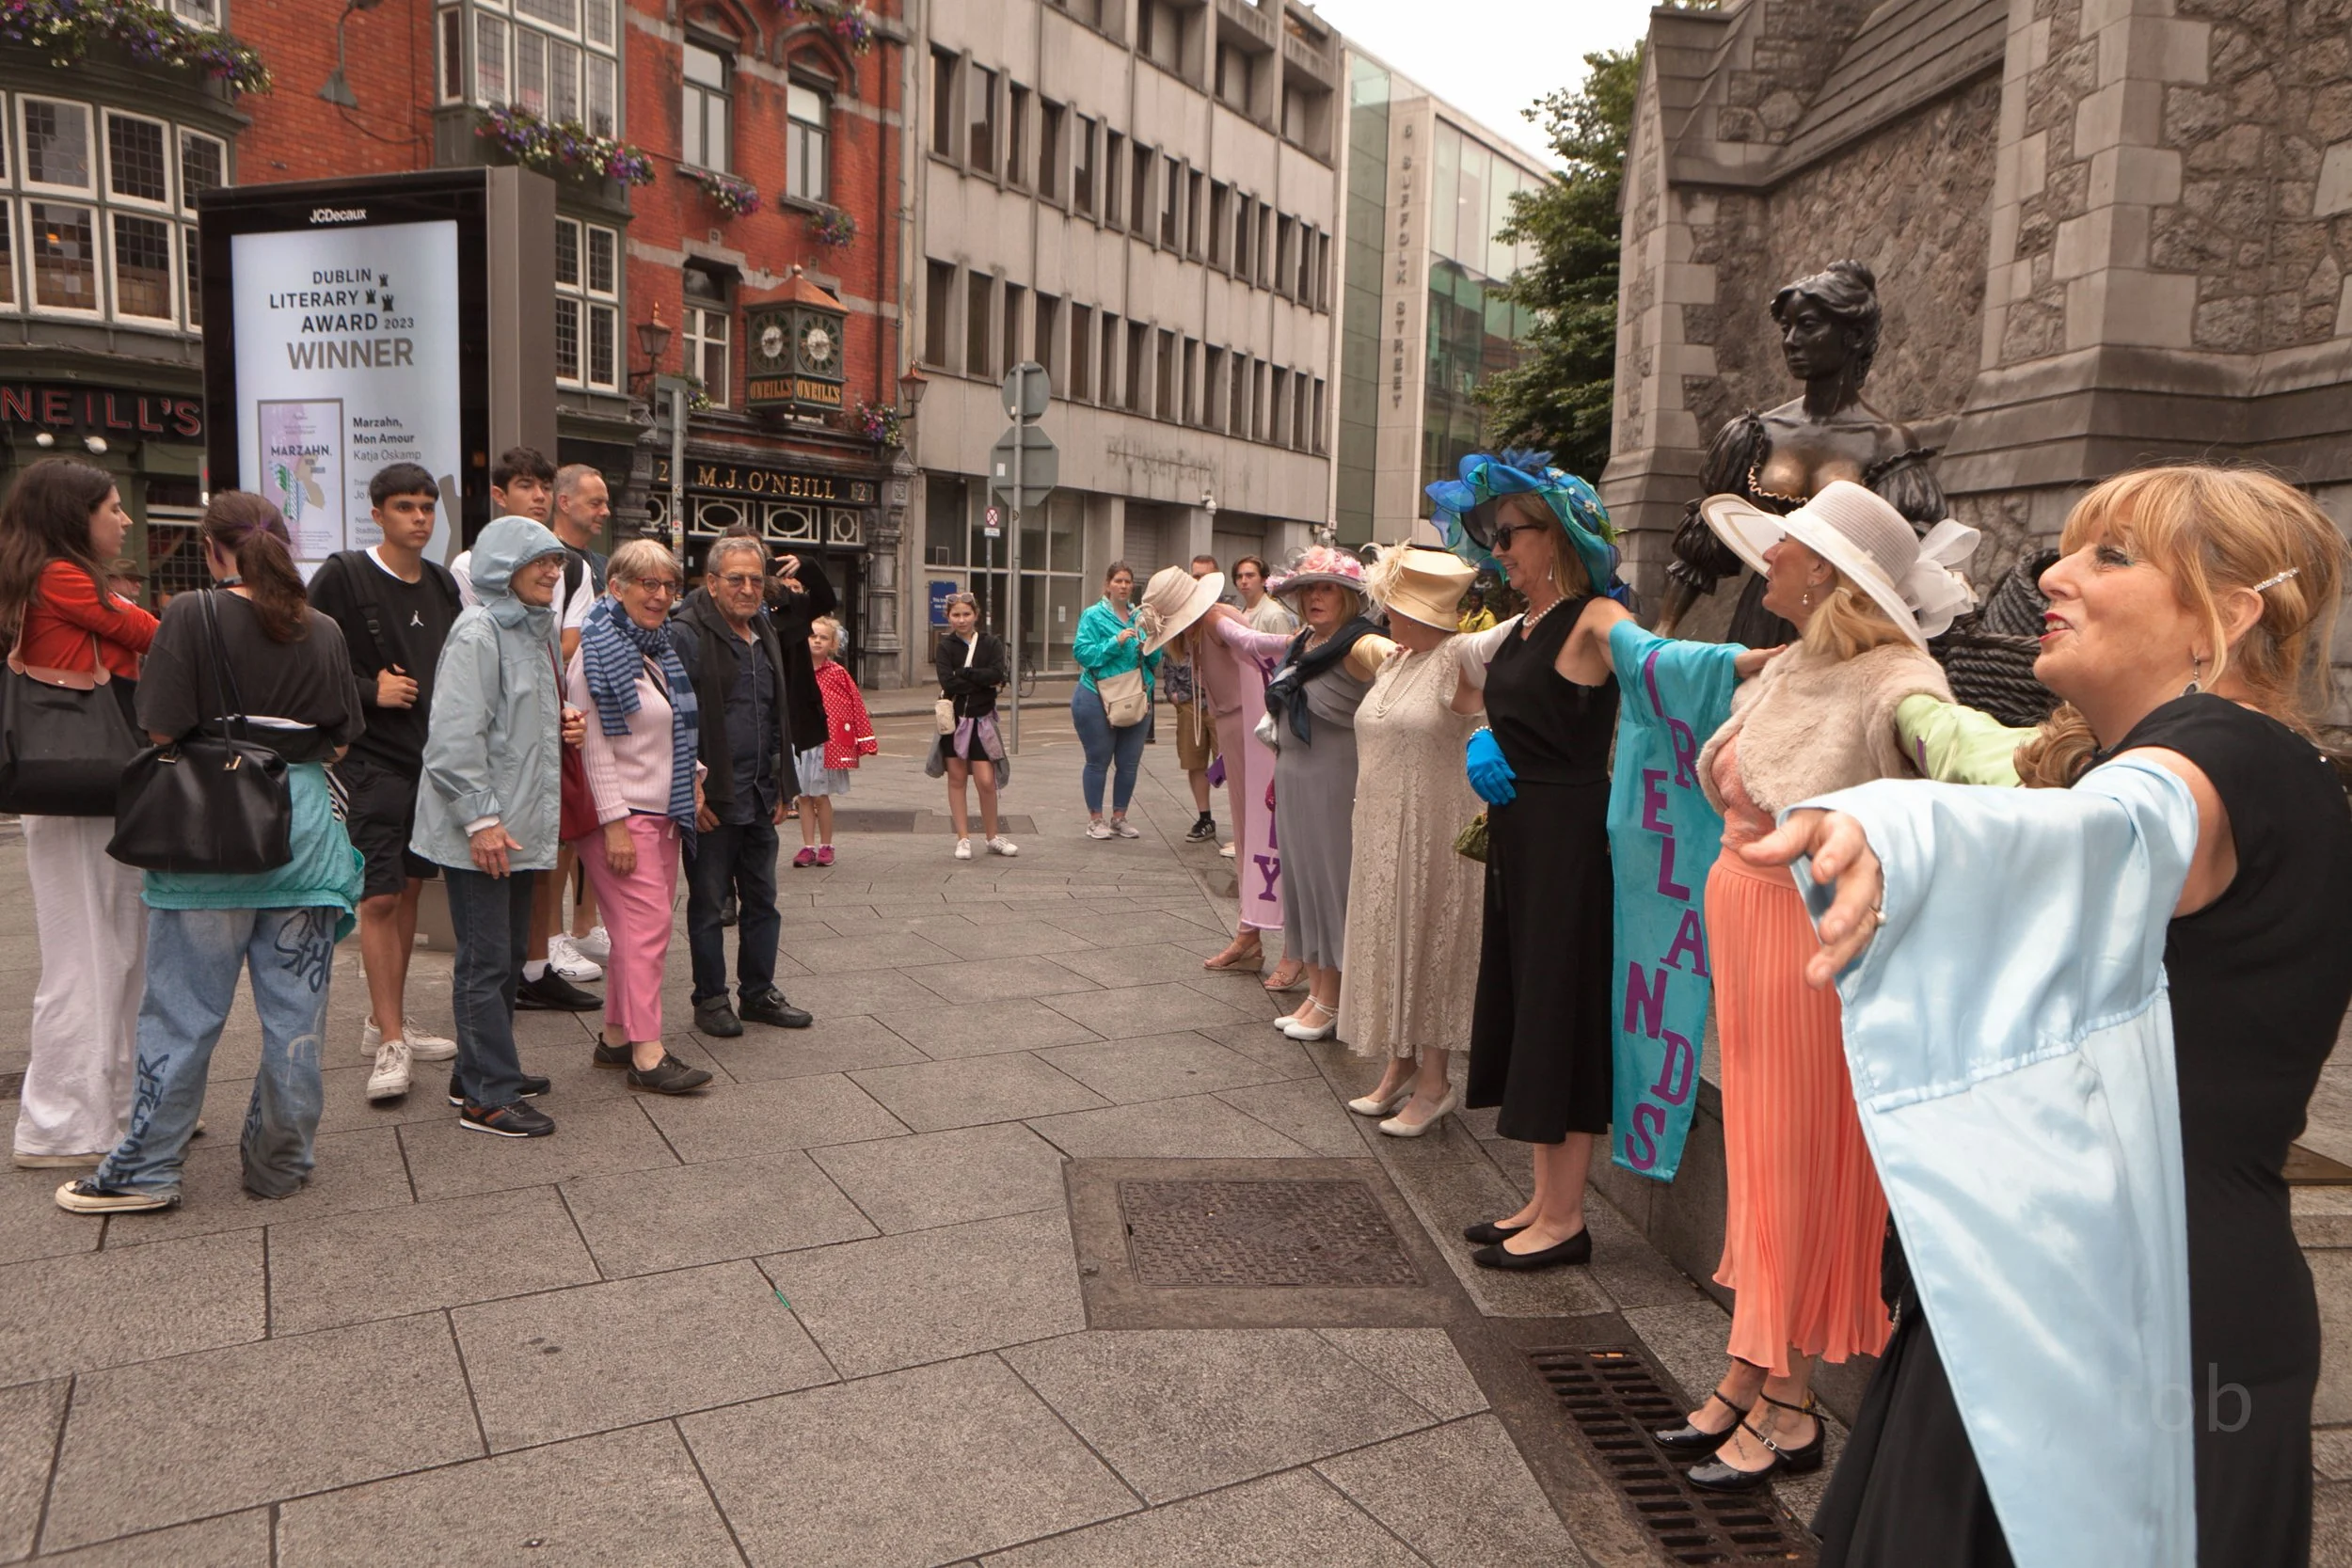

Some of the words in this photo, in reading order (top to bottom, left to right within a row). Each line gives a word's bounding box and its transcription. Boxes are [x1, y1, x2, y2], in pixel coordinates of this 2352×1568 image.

[310, 209, 368, 224] JCDecaux
[1397, 155, 1412, 285] SUFFOLK
[312, 268, 373, 285] DUBLIN
[270, 290, 359, 309] LITERARY
[301, 313, 378, 333] AWARD
[384, 317, 415, 329] 2023
[286, 338, 414, 371] WINNER
[1392, 301, 1406, 410] STREET
[353, 417, 404, 429] Marzahn,
[353, 434, 377, 445] Mon
[378, 433, 415, 444] Amour
[353, 450, 378, 462] Katja
[381, 449, 422, 461] Oskamp
[658, 461, 669, 483] 2
[748, 470, 835, 500] O'NEILL
[857, 481, 866, 502] 2
